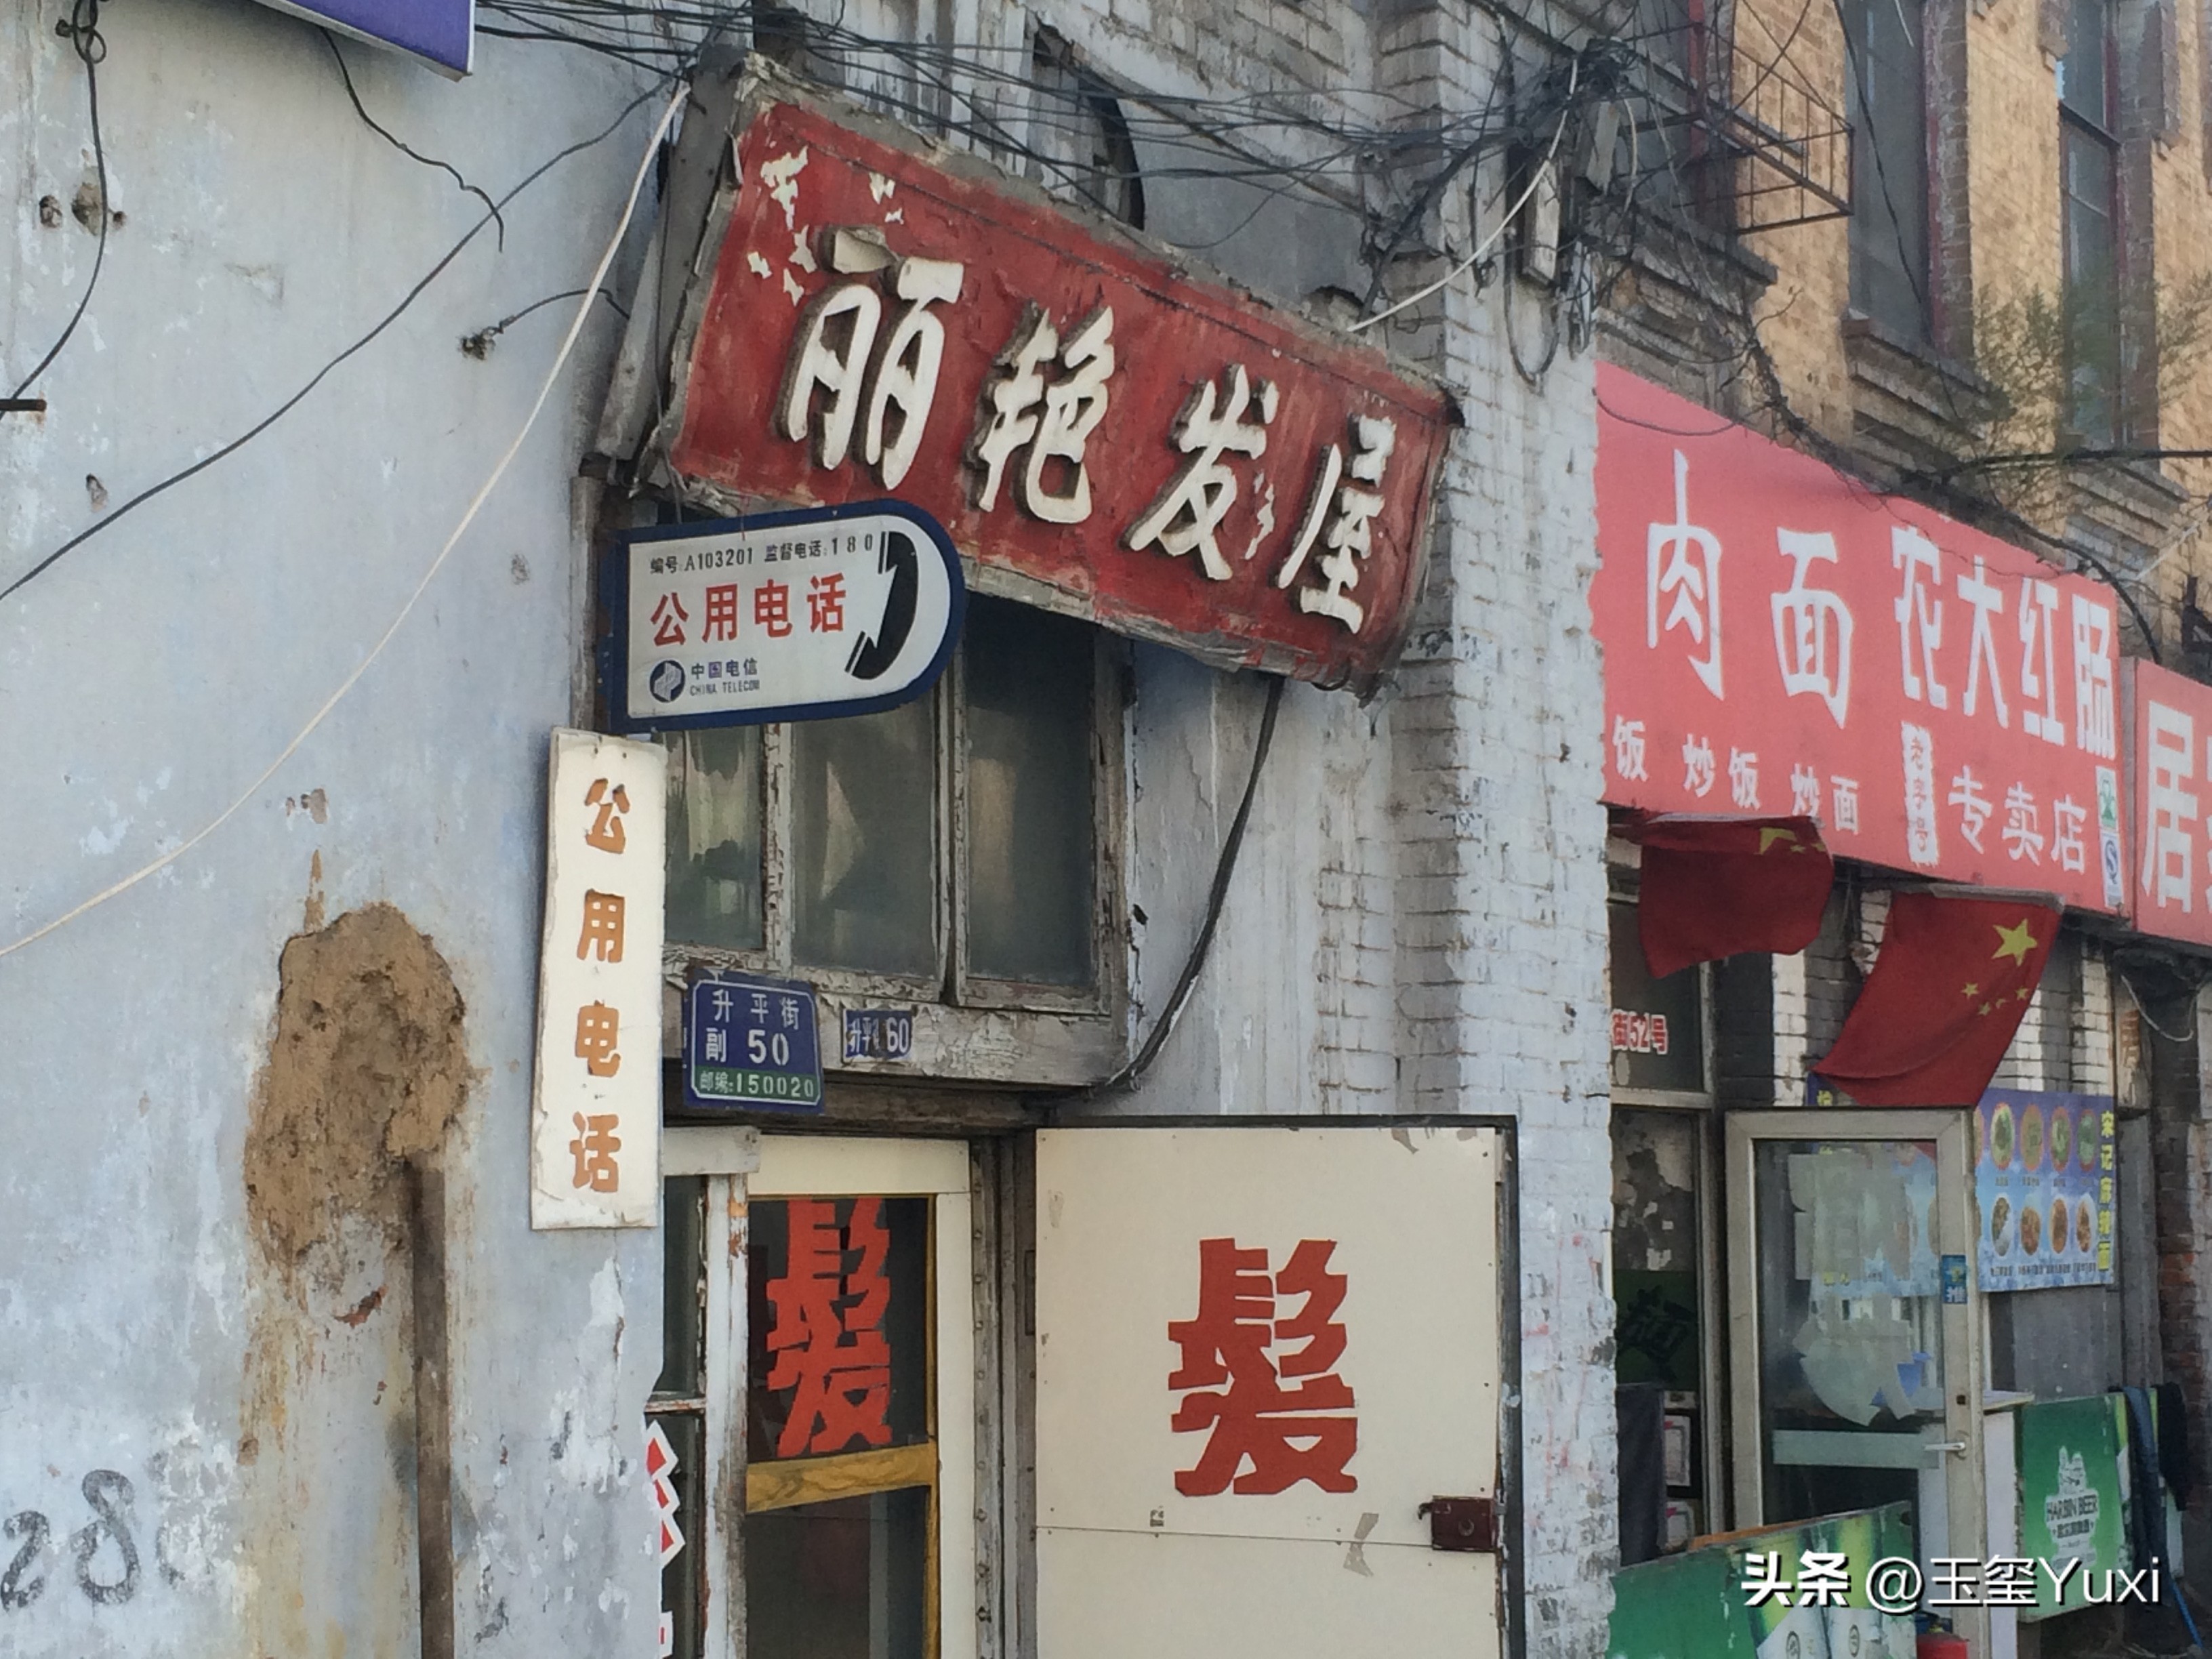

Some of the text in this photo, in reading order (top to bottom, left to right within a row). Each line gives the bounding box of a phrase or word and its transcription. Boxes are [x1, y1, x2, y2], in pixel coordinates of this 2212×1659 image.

[787, 256, 1395, 634] 丽艳发屋
[651, 573, 846, 647] 公用电话
[1891, 526, 2116, 760] 农大红肠
[690, 680, 760, 696] CHINA TELECOM
[691, 657, 758, 680] 中国电信
[1683, 734, 1761, 811] 炒饭
[1791, 764, 1860, 836] 炒面
[2142, 700, 2212, 913] 居
[1948, 765, 2087, 874] 专卖店
[569, 777, 632, 1193] 公用电话
[712, 989, 800, 1030] 升平街
